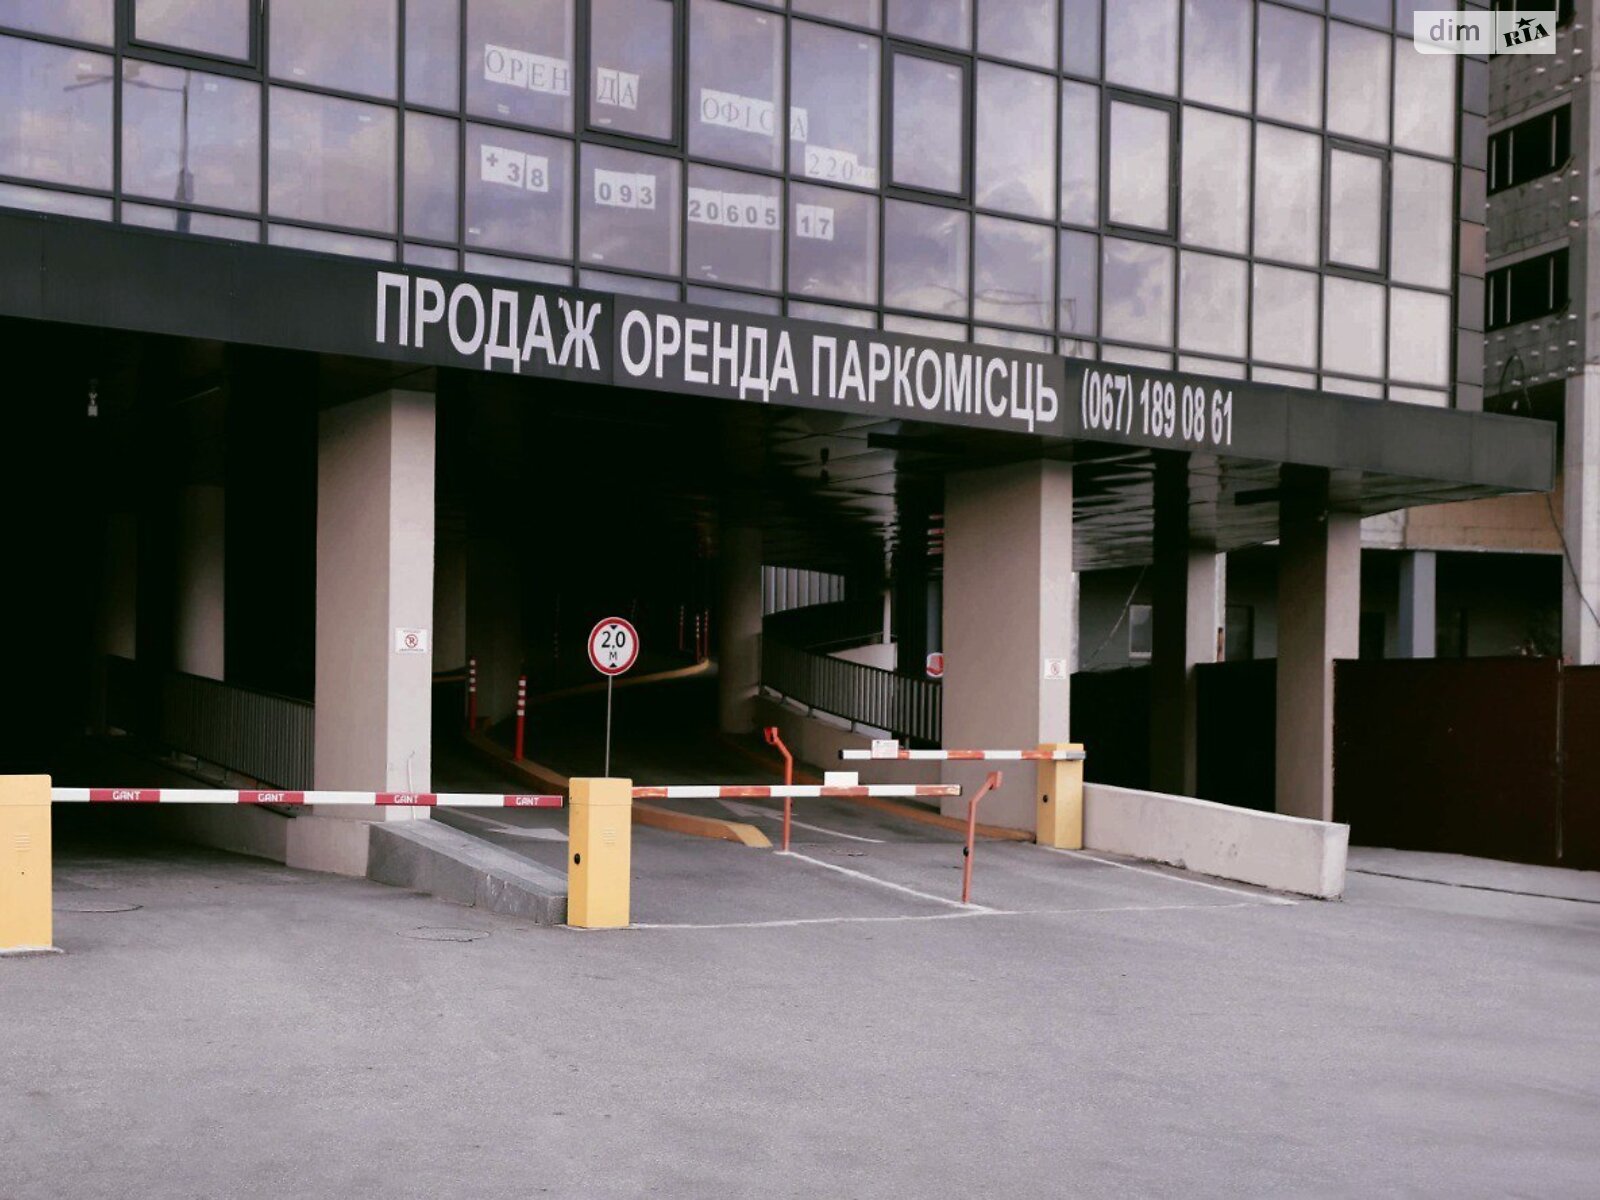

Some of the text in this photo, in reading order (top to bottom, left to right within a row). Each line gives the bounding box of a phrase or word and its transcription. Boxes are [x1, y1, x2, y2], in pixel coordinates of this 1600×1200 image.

[485, 152, 544, 188] +38
[599, 182, 653, 206] 093
[800, 214, 831, 238] 17
[376, 271, 1059, 433] ПРОДАЖ ОРЕНДА ПАРКОМІСЦЬ
[1081, 368, 1234, 446] (067) 189 08 61
[112, 791, 141, 801] GANT
[257, 793, 285, 802] GANT
[393, 794, 419, 804] GANT
[515, 797, 539, 806] GANT
